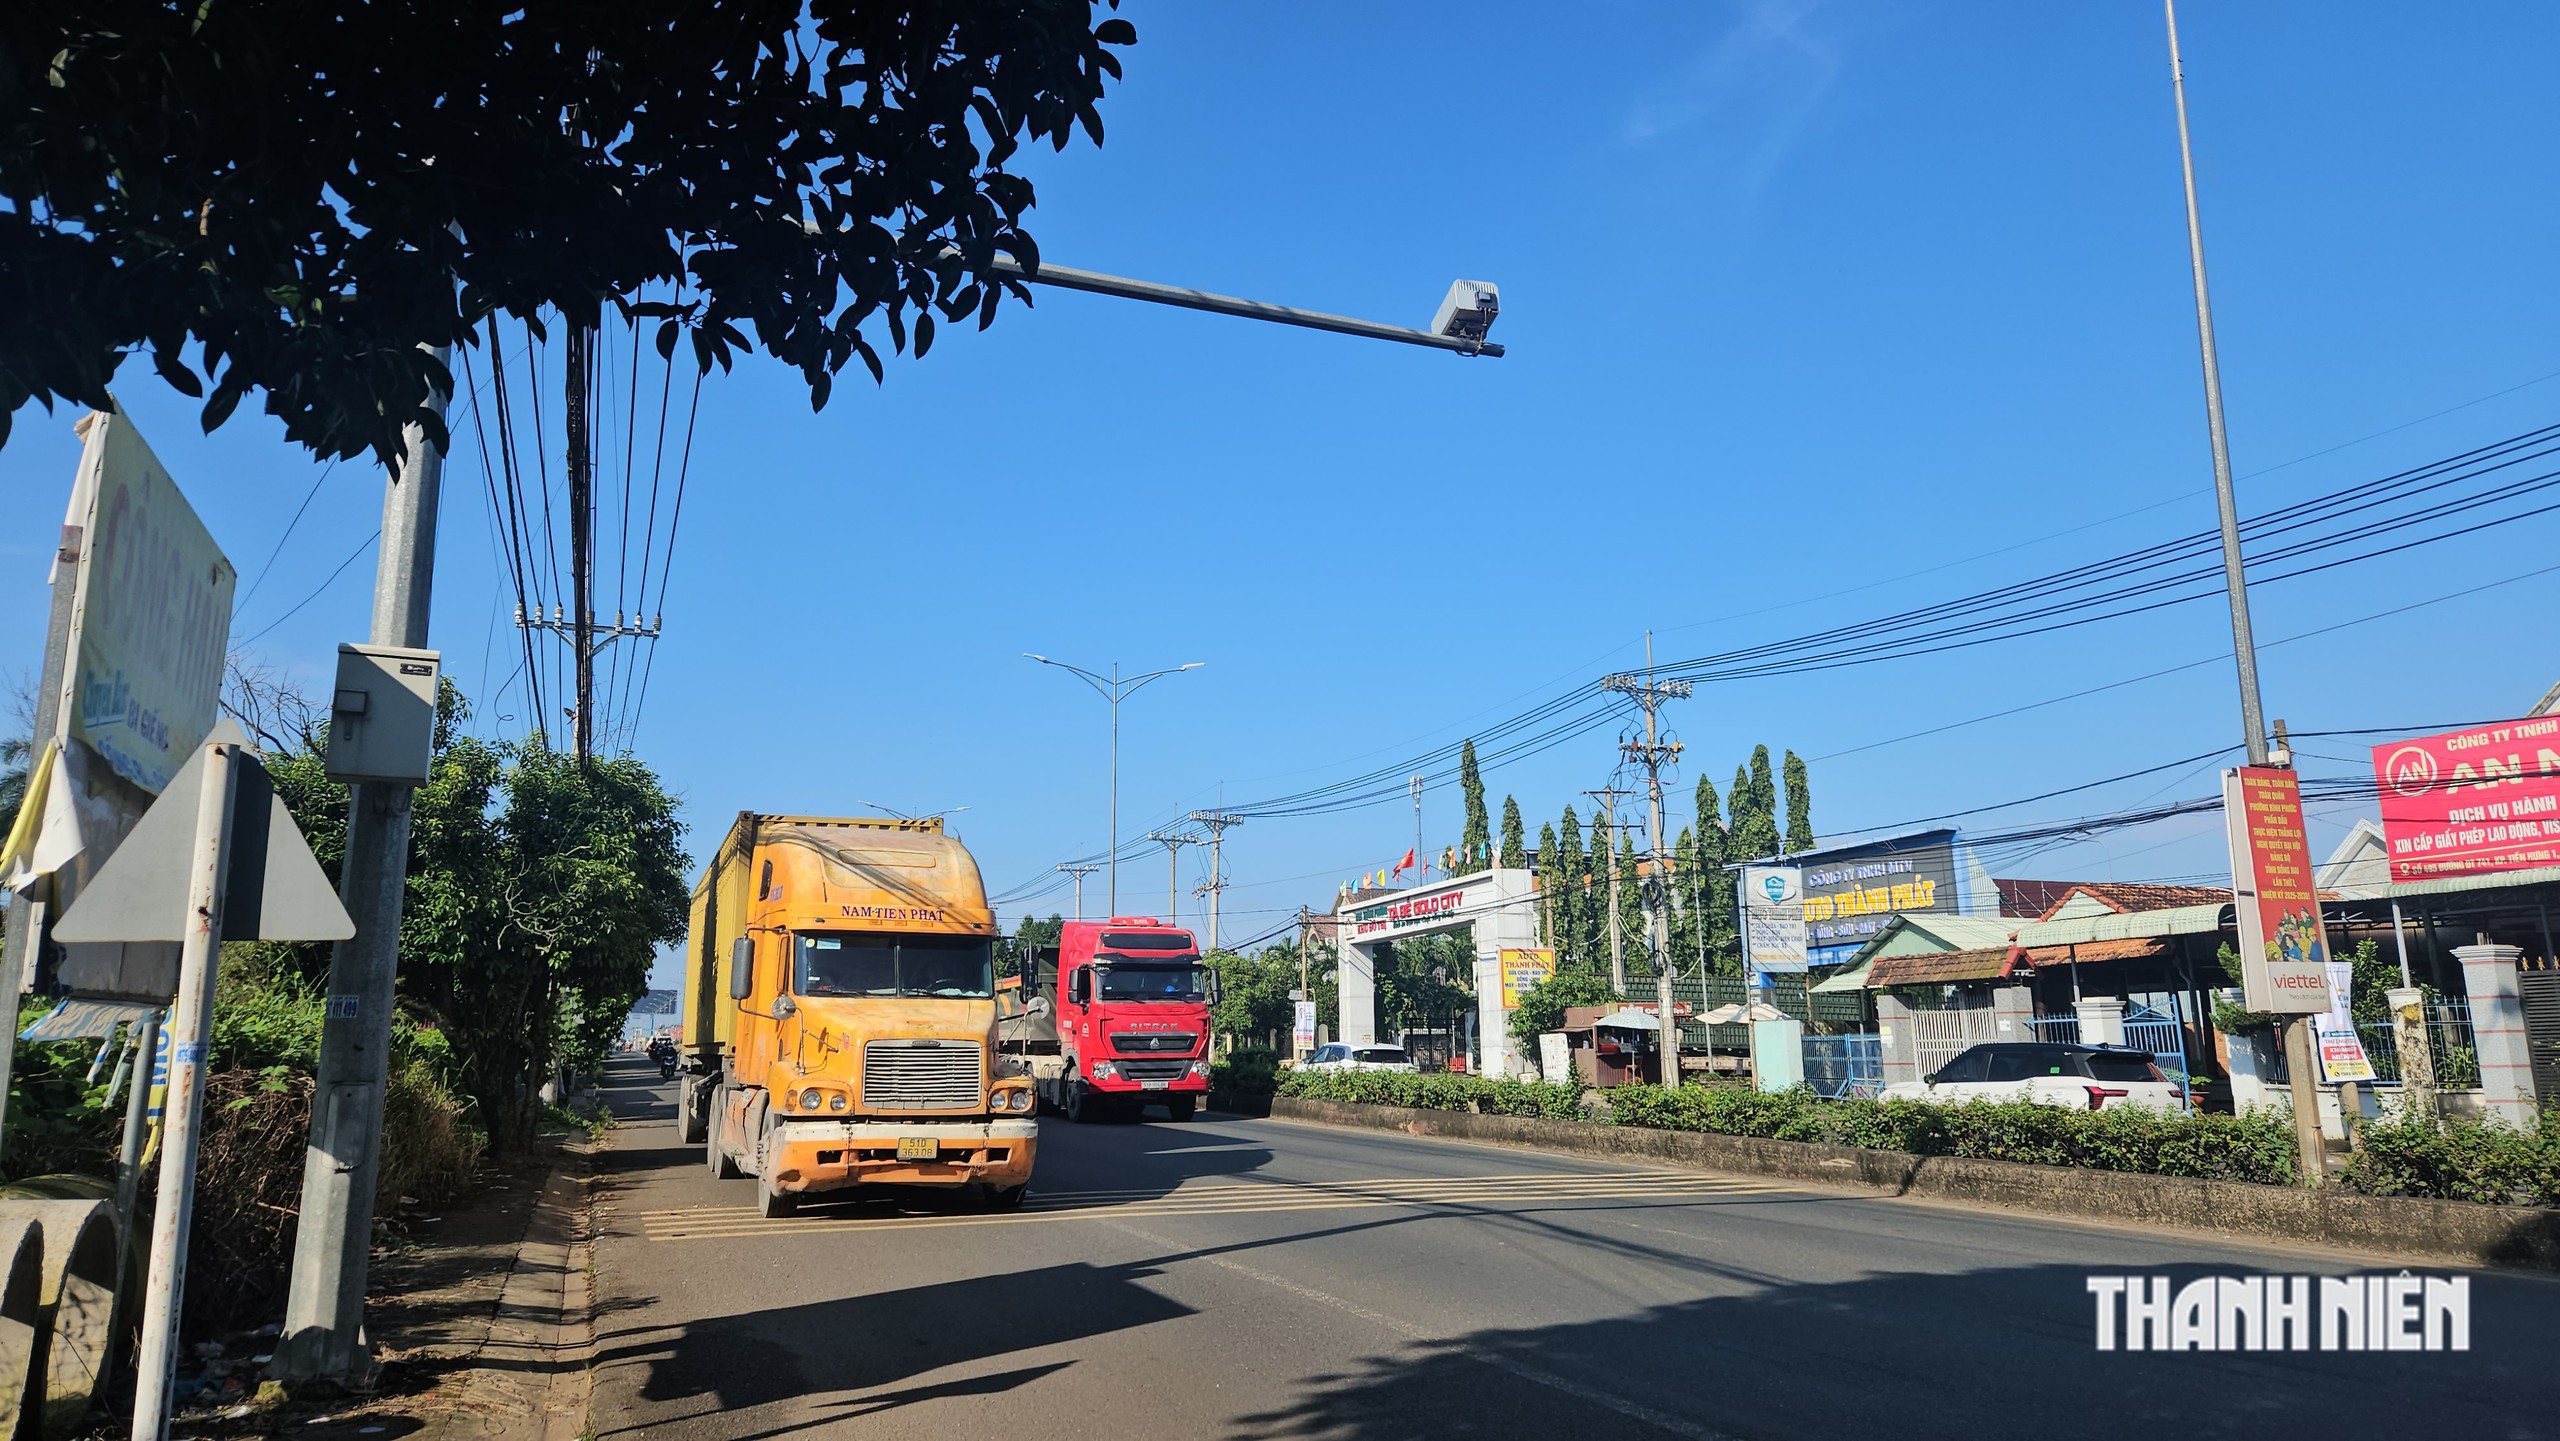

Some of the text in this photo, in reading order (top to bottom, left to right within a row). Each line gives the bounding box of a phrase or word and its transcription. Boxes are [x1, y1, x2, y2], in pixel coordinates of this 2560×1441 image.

[2447, 720, 2558, 751] CÔNG TY TNHH
[2446, 754, 2524, 795] AN
[2449, 795, 2557, 826] DỊCH VỤ HÀNH
[2394, 838, 2412, 854] XIN
[2413, 832, 2432, 852] CẤP
[2435, 828, 2457, 849] GIẤY
[2459, 826, 2486, 846] PHÉP
[2487, 827, 2507, 842] LAO
[2508, 821, 2542, 842] ĐỘNG,
[1808, 860, 1913, 888] CÔNG TY TNHH MTV
[2412, 862, 2422, 875] SỐ
[2423, 863, 2438, 874] 495
[2439, 858, 2465, 872] ĐƯỜNG
[2507, 851, 2526, 864] TIẾN
[2526, 849, 2550, 862] HƯNG
[1440, 891, 1464, 911] CITY
[1803, 874, 1936, 923] UTO THÀNH PHÁT
[910, 909, 945, 921] PHAT
[1505, 960, 1530, 968] THÀNH
[2273, 974, 2325, 989] viettel
[902, 1148, 933, 1157] 363.08
[909, 1139, 927, 1148] 51D
